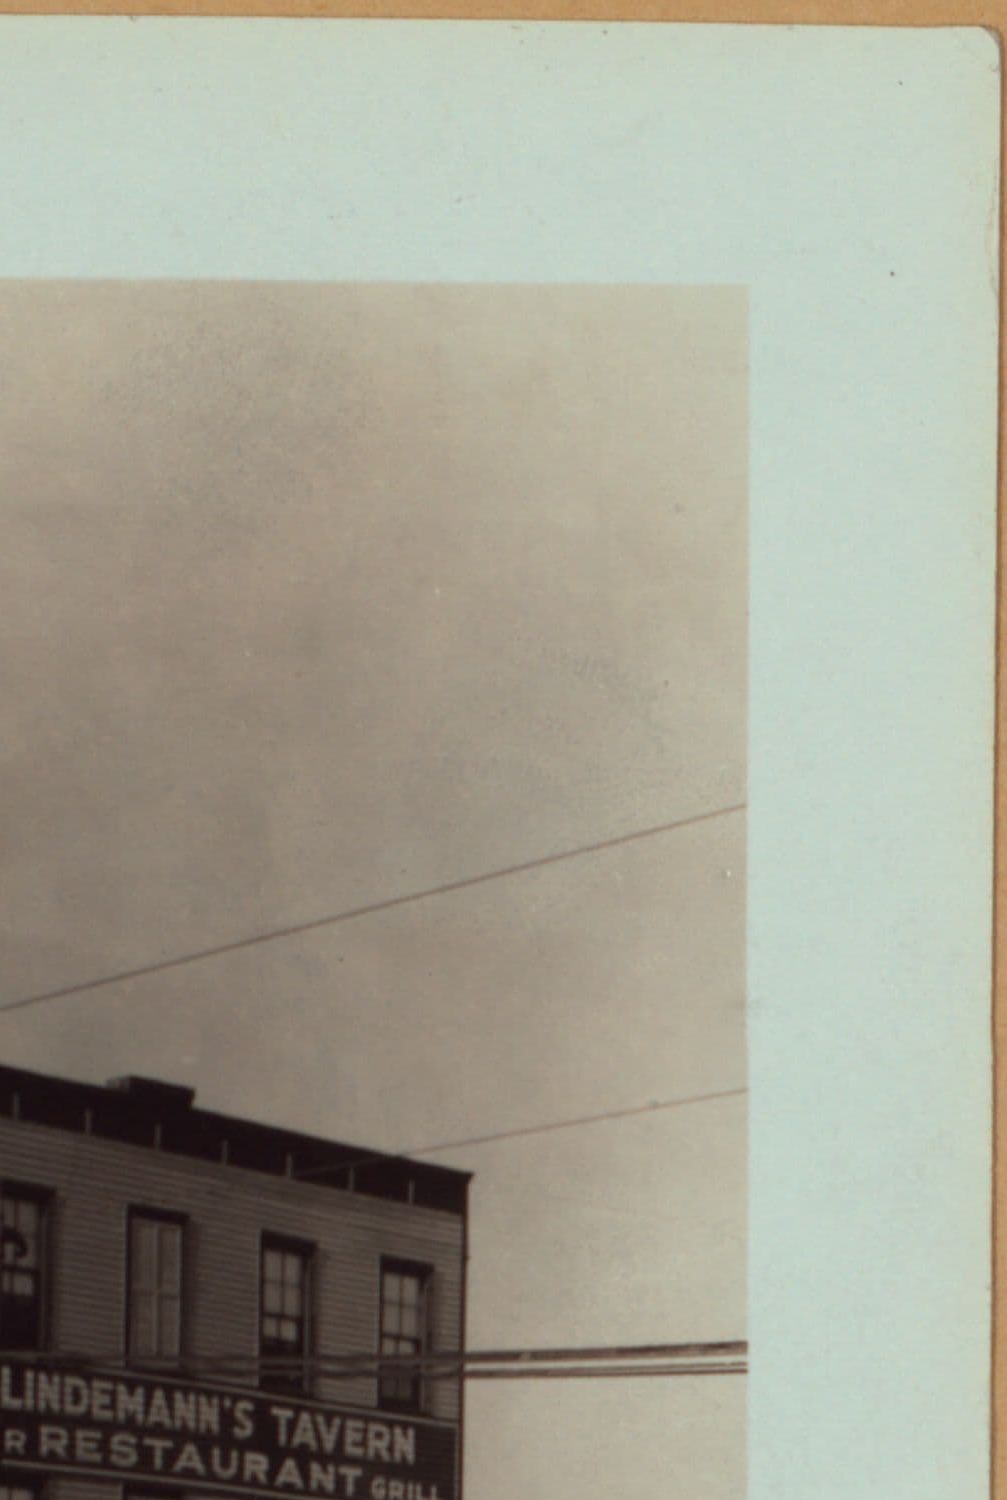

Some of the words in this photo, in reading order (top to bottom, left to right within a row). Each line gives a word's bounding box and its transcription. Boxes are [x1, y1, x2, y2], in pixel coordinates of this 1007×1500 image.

[0, 1366, 255, 1438] LINDEMANN'S
[271, 1407, 417, 1465] TAVERN
[39, 1426, 363, 1497] RESTAURANT
